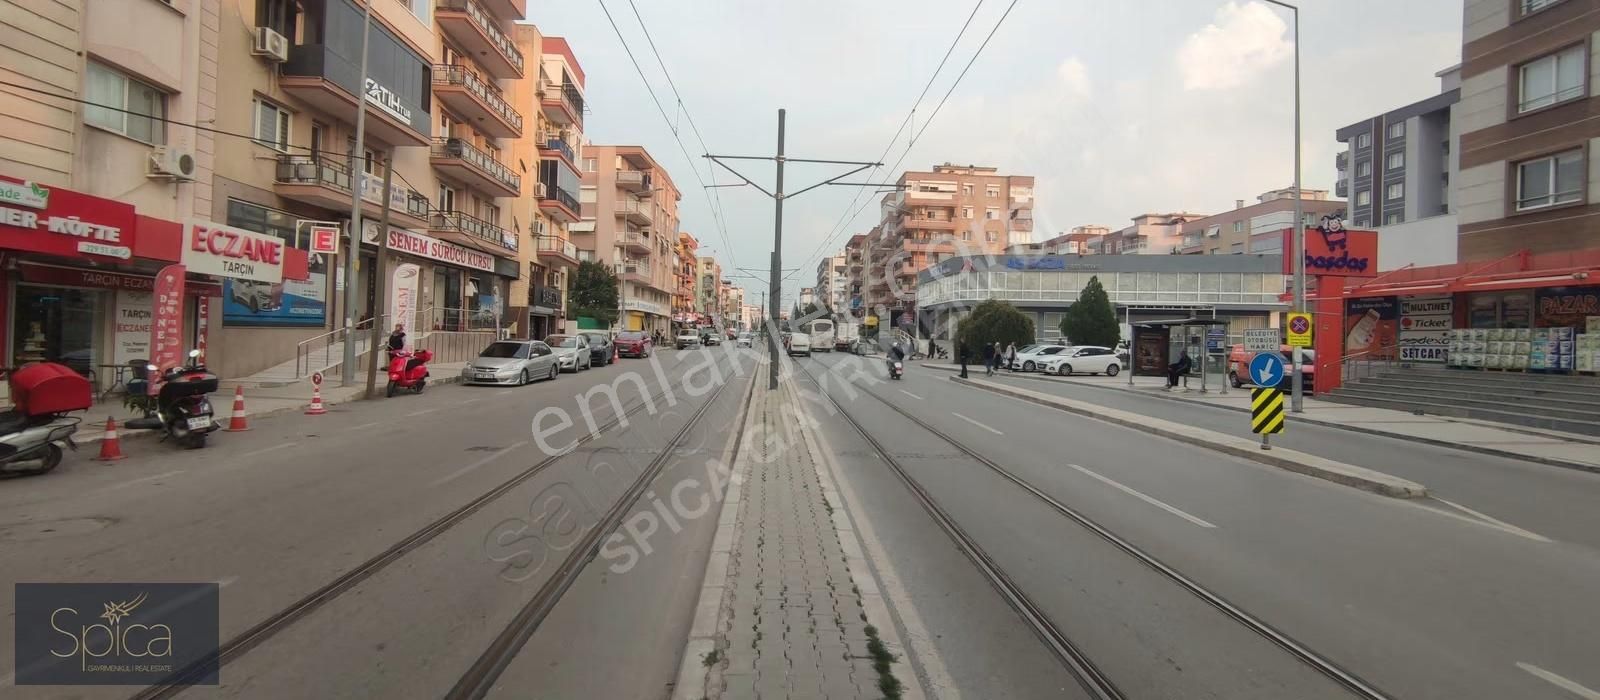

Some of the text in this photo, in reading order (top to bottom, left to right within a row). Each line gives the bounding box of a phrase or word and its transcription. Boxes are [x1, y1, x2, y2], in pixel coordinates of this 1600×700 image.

[192, 224, 281, 265] ECZANE
[317, 231, 333, 251] E
[388, 230, 492, 270] SENEM SÜRÜCÜ KURSU
[222, 260, 254, 276] TARÇIN
[1411, 302, 1450, 312] MULTINET
[1414, 318, 1448, 328] Ticket
